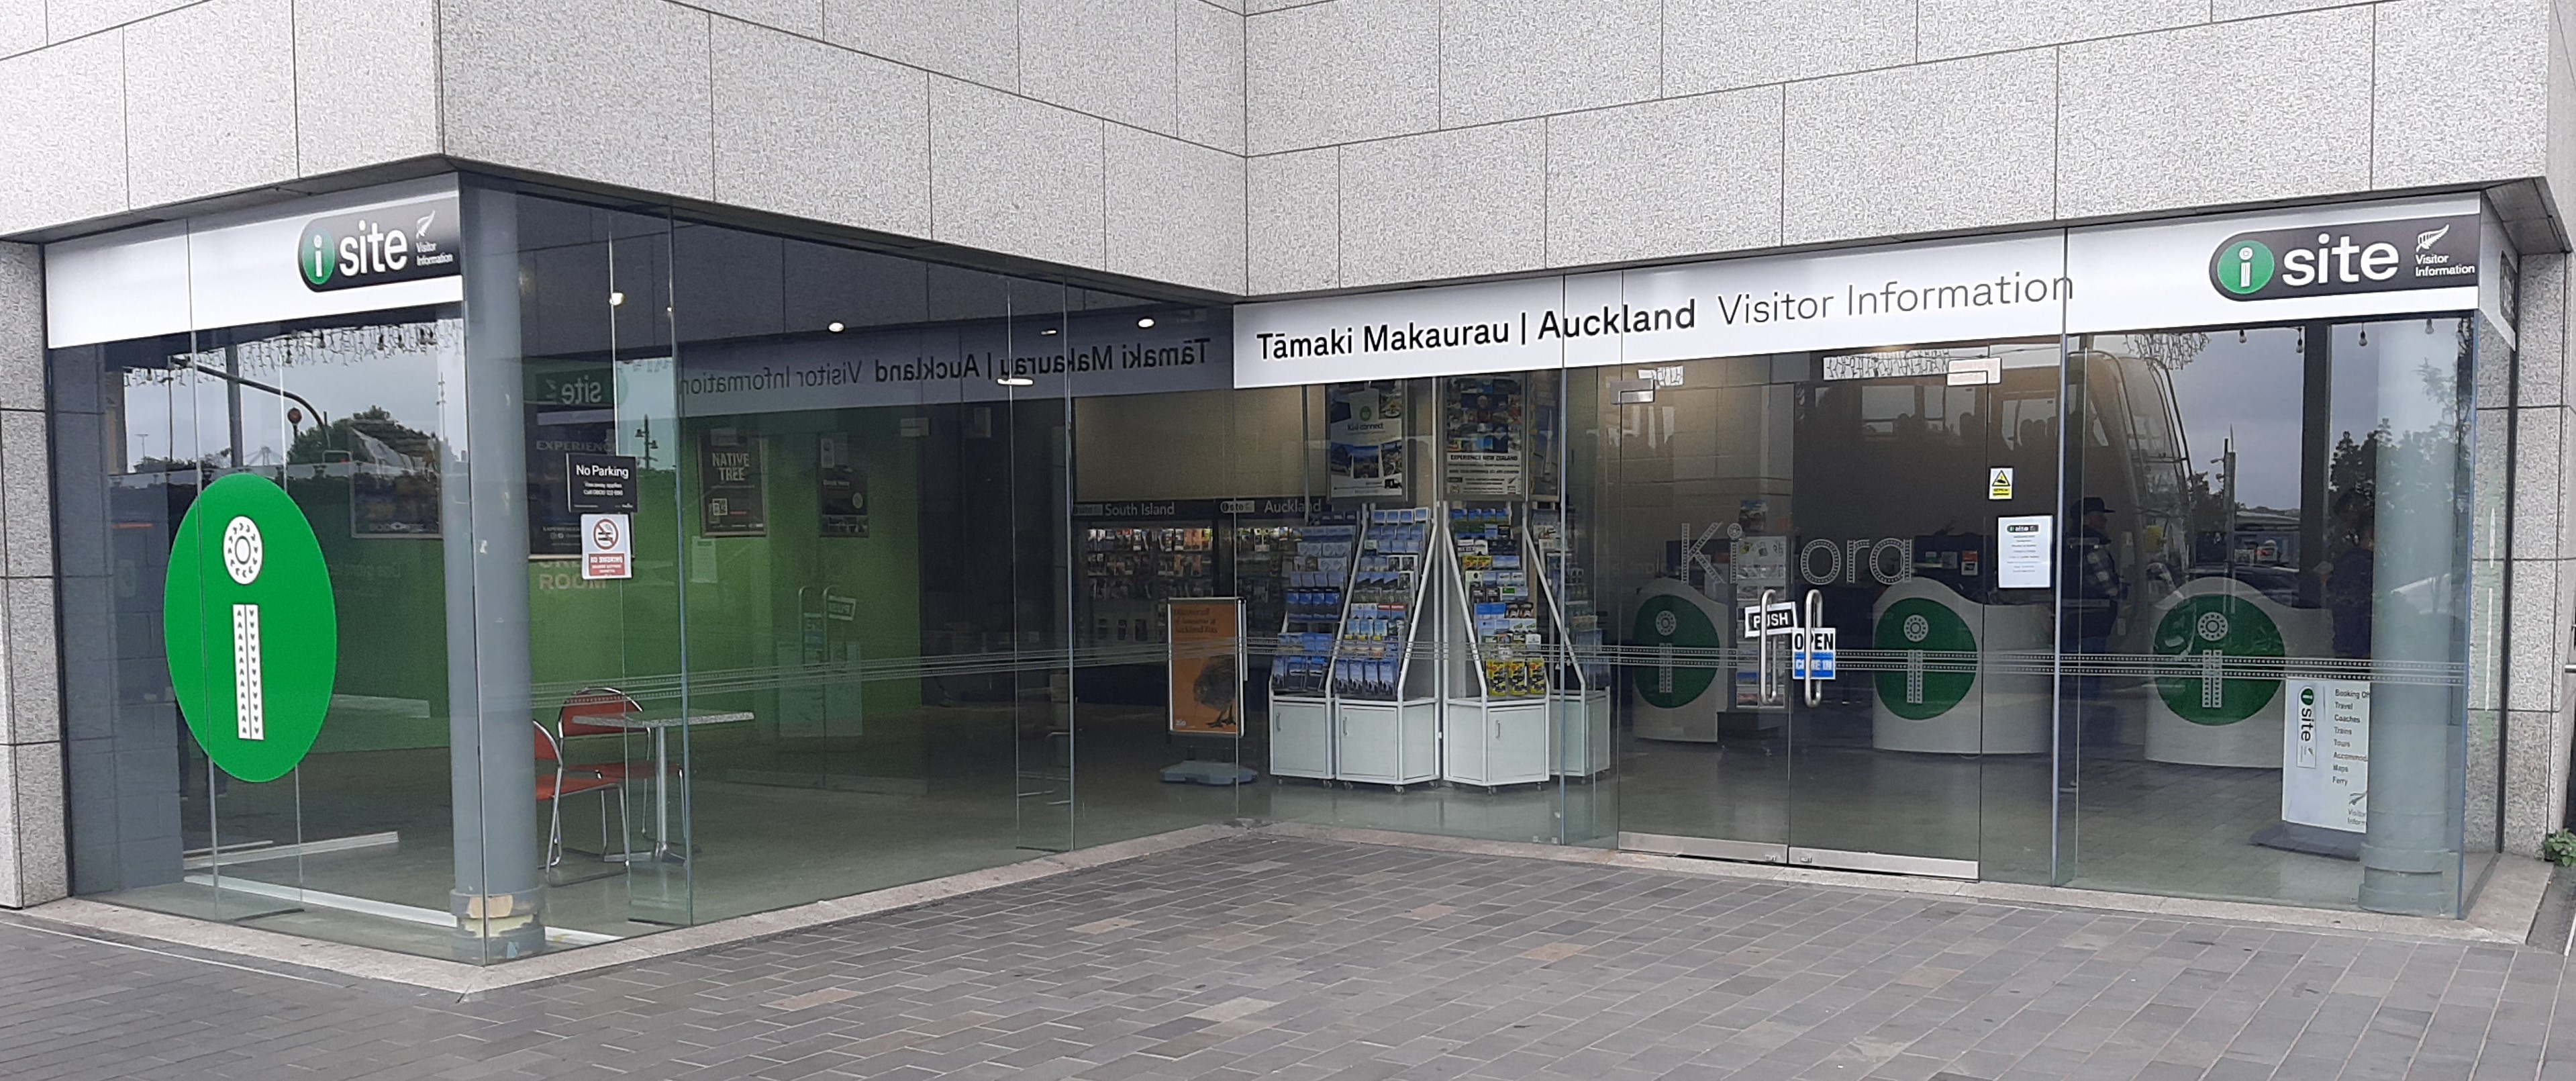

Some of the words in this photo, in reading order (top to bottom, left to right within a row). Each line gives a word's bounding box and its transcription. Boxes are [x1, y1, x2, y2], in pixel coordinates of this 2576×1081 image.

[339, 220, 408, 277] site
[415, 241, 436, 253] Visitor
[416, 252, 453, 267] Information
[2282, 233, 2399, 287] site
[2416, 254, 2450, 265] Visitor
[2416, 265, 2476, 277] Information
[1256, 327, 1353, 360] Tāmaki
[1364, 322, 1509, 352] Makaurau
[1538, 299, 1696, 340] Auckland
[1718, 291, 1834, 326] Visitor
[1848, 272, 2074, 317] Information
[712, 453, 749, 467] NATIVE
[576, 464, 591, 476] No
[592, 465, 630, 480] Parking
[718, 467, 745, 481] TREE
[1105, 503, 1138, 516] South
[1141, 502, 1175, 515] Island
[1230, 502, 1244, 510] ste
[1794, 632, 1834, 651] OEN
[2335, 689, 2361, 700] Booking
[2334, 701, 2353, 710] Travel
[2301, 707, 2315, 742] site
[2334, 714, 2361, 724] Coaches
[2334, 726, 2352, 735] Trains
[2334, 739, 2350, 747] Tours
[2332, 764, 2349, 773] Maps
[2332, 775, 2348, 786] Ferry
